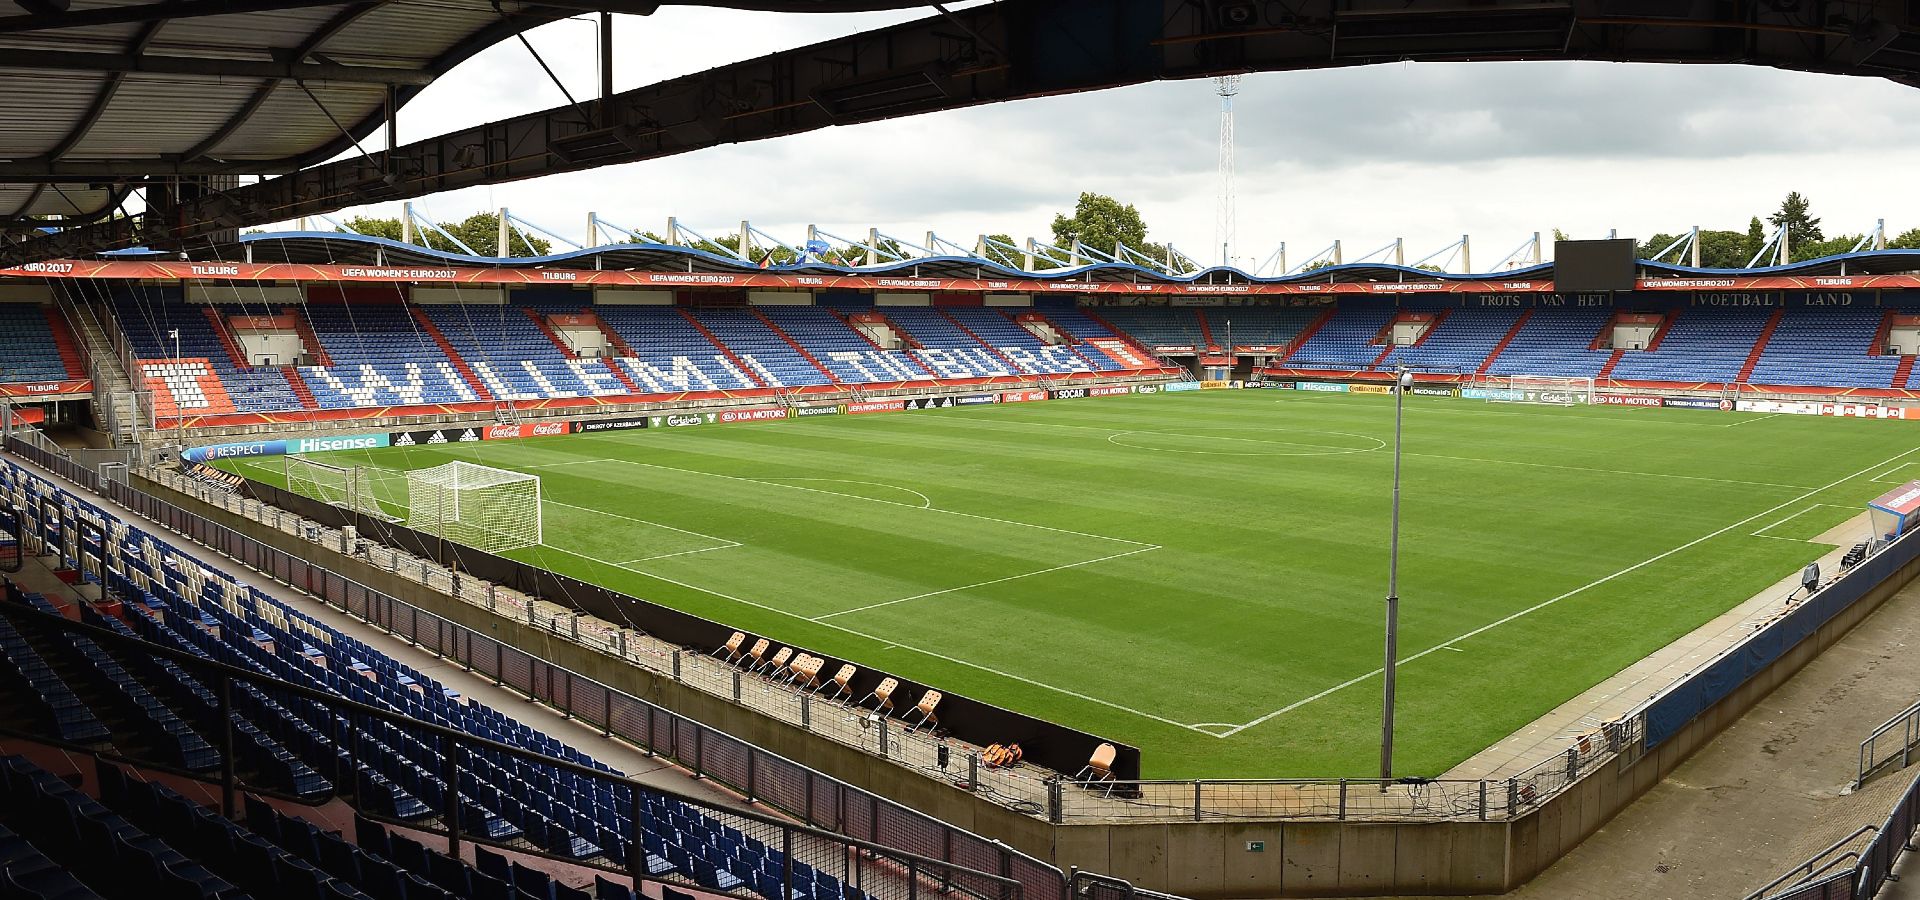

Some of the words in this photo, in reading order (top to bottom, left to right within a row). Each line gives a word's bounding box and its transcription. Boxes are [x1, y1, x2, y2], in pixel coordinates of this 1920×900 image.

[46, 263, 73, 273] 2017
[191, 266, 238, 275] TILBURG
[341, 268, 366, 277] UEFA
[366, 269, 409, 278] WOMEN'S
[410, 270, 435, 278] EURO
[435, 271, 457, 279] 2017
[542, 272, 576, 280] TILBURG
[650, 274, 669, 282] UEFA
[669, 275, 700, 283] WOMEN'S
[719, 276, 735, 284] 2017
[797, 277, 823, 285] TILBURG
[1479, 295, 1521, 307] TROTS
[1541, 294, 1566, 306] VAN
[1577, 294, 1606, 306] HET
[1699, 293, 1774, 306] VOETBAL
[1805, 293, 1852, 305] LAND
[27, 384, 60, 392] TILBURG
[1109, 387, 1129, 395] MOTORS
[1303, 382, 1342, 392] Hisense
[1413, 388, 1451, 396] McDonald's
[1058, 389, 1085, 399] SOCAR
[1608, 396, 1623, 404] KIA
[1624, 398, 1660, 406] MOTORS
[798, 406, 837, 416] McDonald's
[848, 404, 863, 412] UEFA
[862, 403, 889, 411] WOMEN'S
[737, 411, 752, 420] KIA
[752, 409, 786, 419] MOTORS
[667, 414, 702, 427] Carlsberg
[300, 437, 377, 452] Hisense
[217, 444, 266, 457] RESPECT
